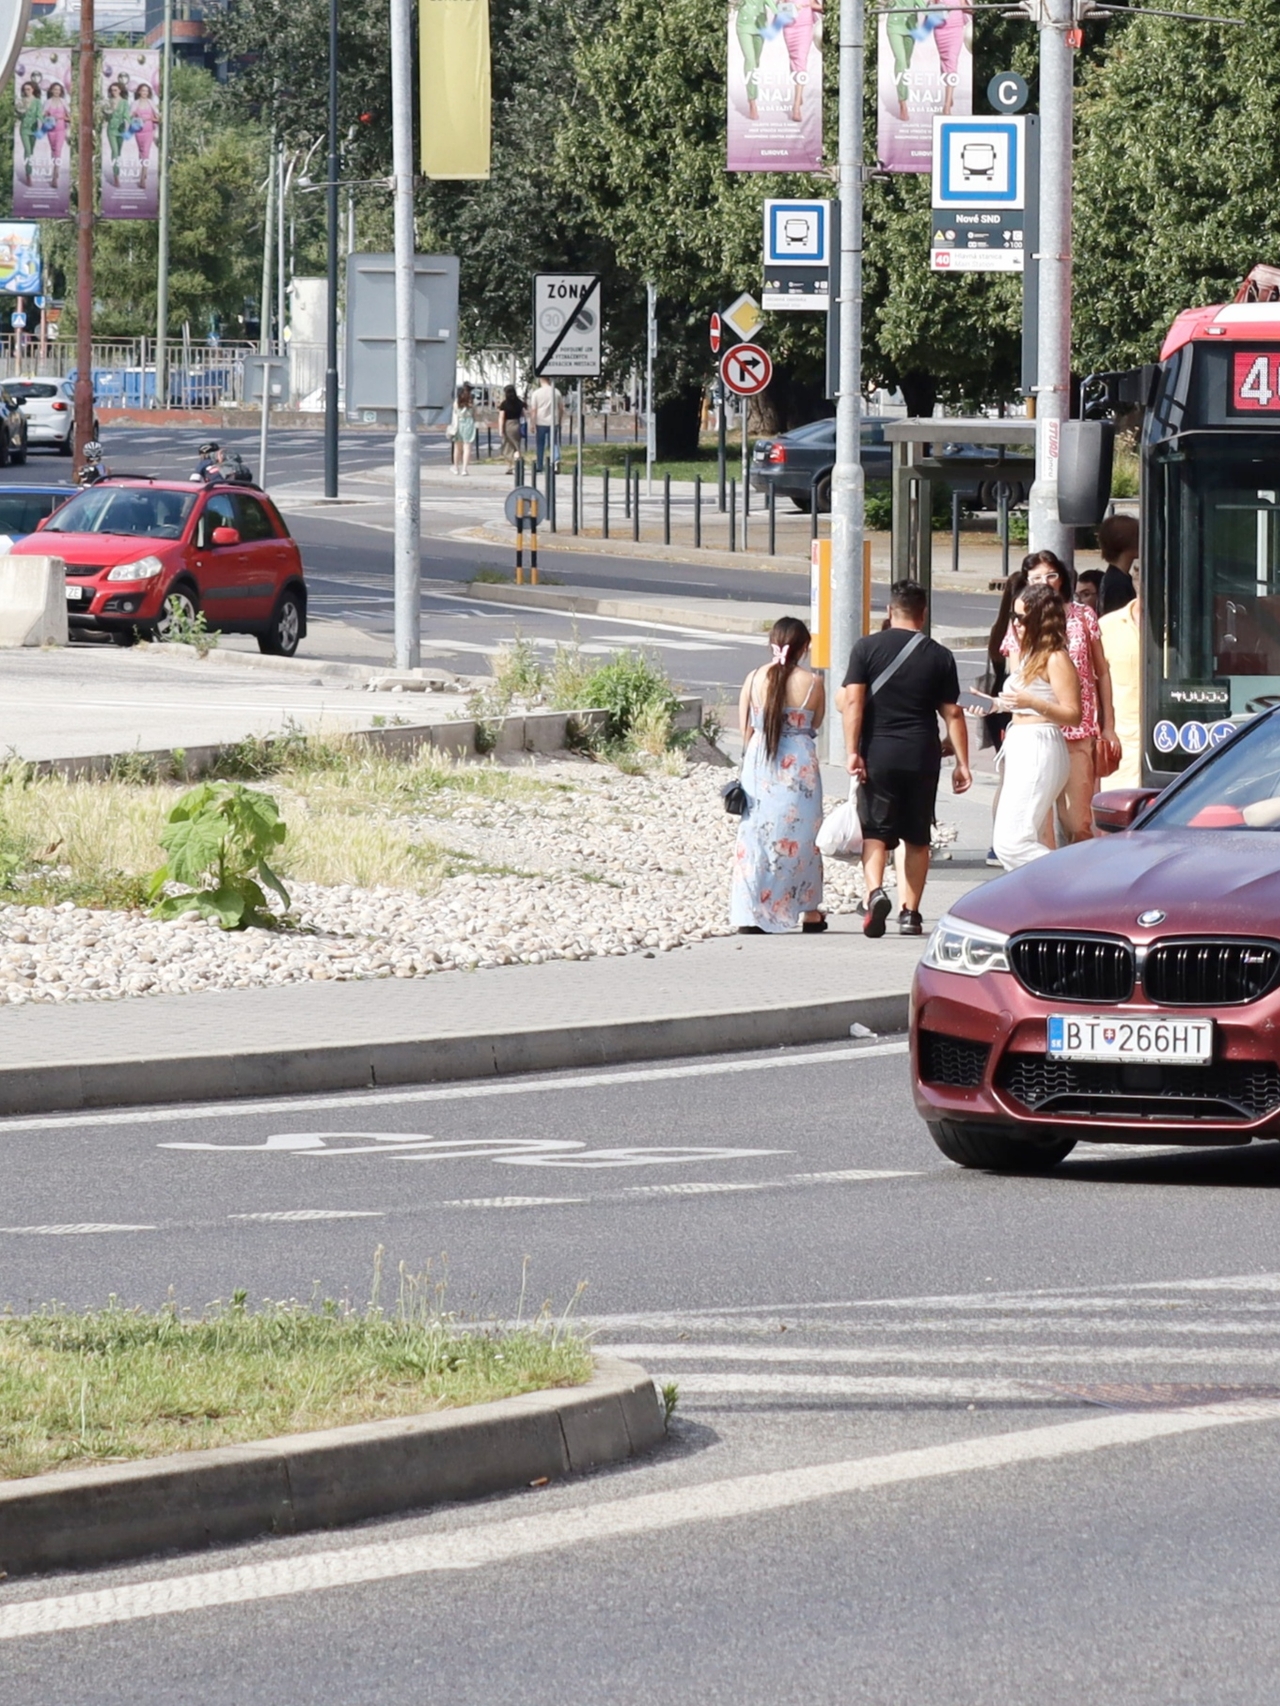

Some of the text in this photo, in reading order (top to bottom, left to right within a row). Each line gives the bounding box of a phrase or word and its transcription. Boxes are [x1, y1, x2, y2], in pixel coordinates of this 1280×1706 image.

[740, 68, 810, 86] VŠETKO
[890, 69, 960, 87] VŠETKO
[759, 88, 792, 102] NAJ
[909, 89, 942, 103] NAJ
[998, 80, 1018, 105] C
[955, 213, 1001, 224] Nové SND
[936, 254, 950, 265] 40
[547, 280, 588, 299] ZÓNA
[544, 314, 560, 328] 30
[1051, 1039, 1062, 1048] SK
[1067, 1022, 1207, 1054] BT 266HT
[155, 1132, 798, 1168] BUS
